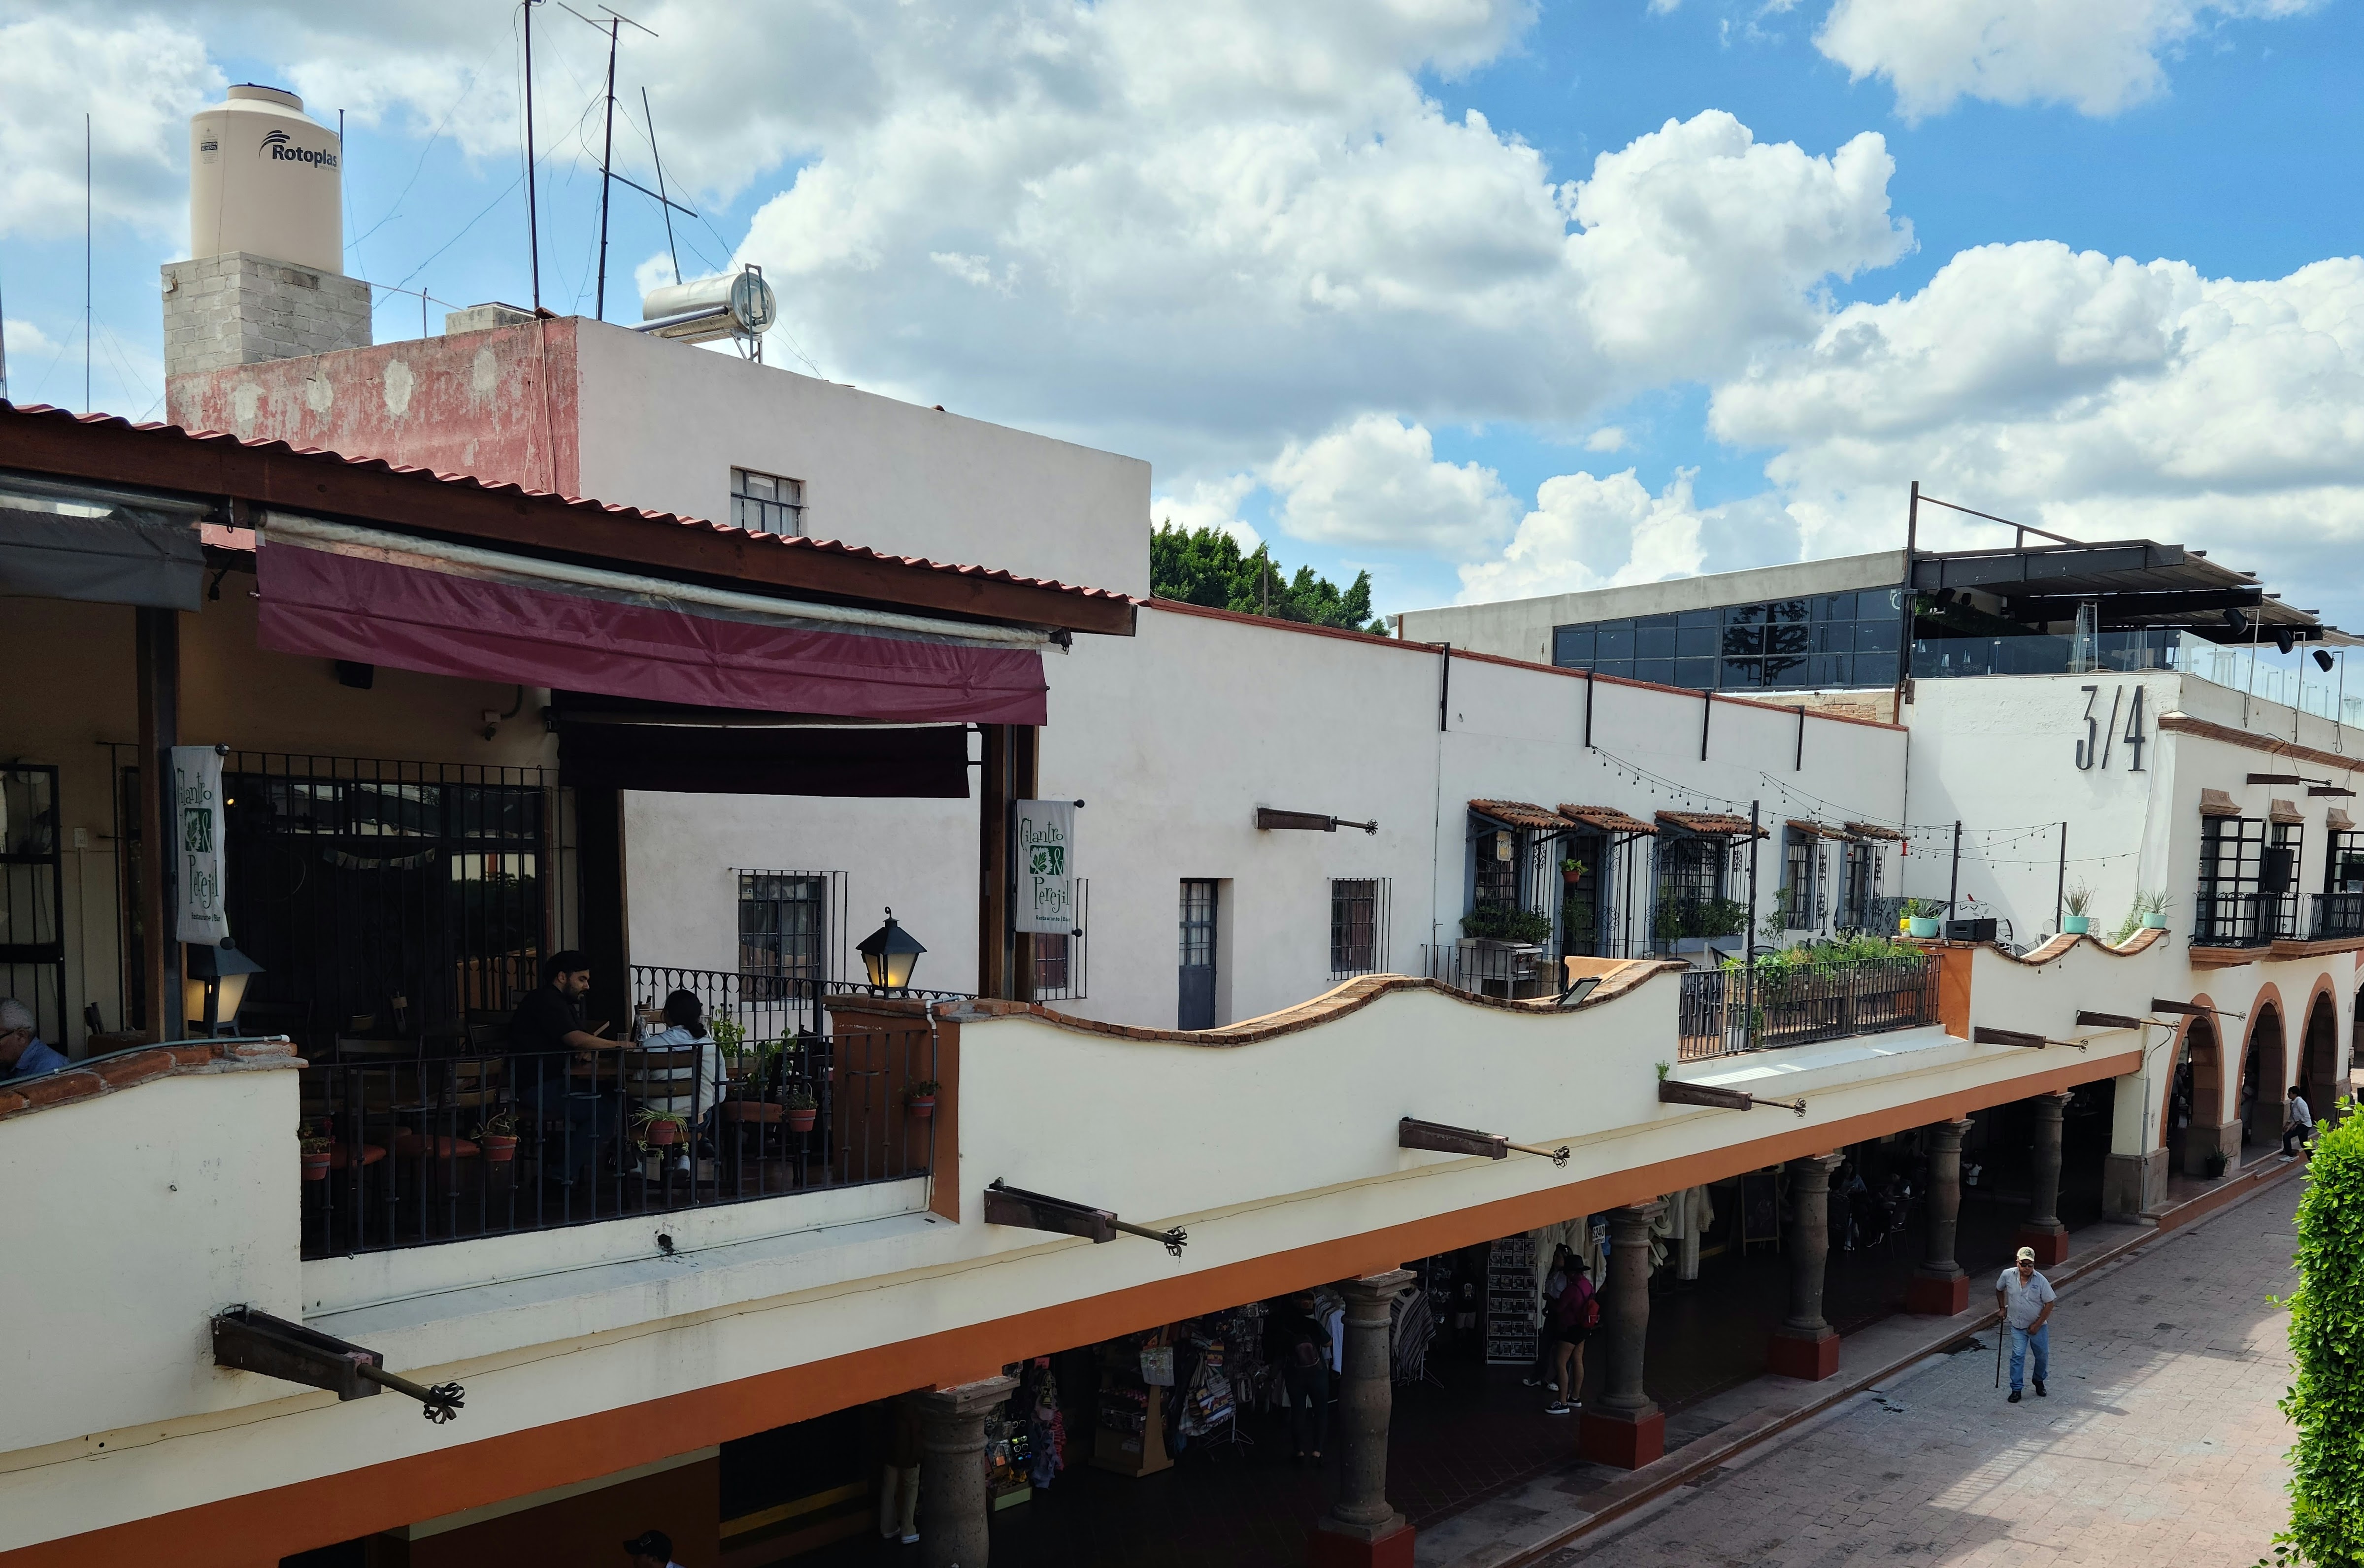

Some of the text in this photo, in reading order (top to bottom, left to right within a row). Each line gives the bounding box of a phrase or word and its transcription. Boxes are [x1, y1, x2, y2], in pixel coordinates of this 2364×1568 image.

[272, 144, 337, 168] Rotoplas
[2075, 685, 2147, 771] 3/4
[1020, 818, 1064, 851] Cilantro
[188, 855, 219, 908] Perejil
[1032, 876, 1070, 913] Perejil
[1593, 1226, 1604, 1239] $240
